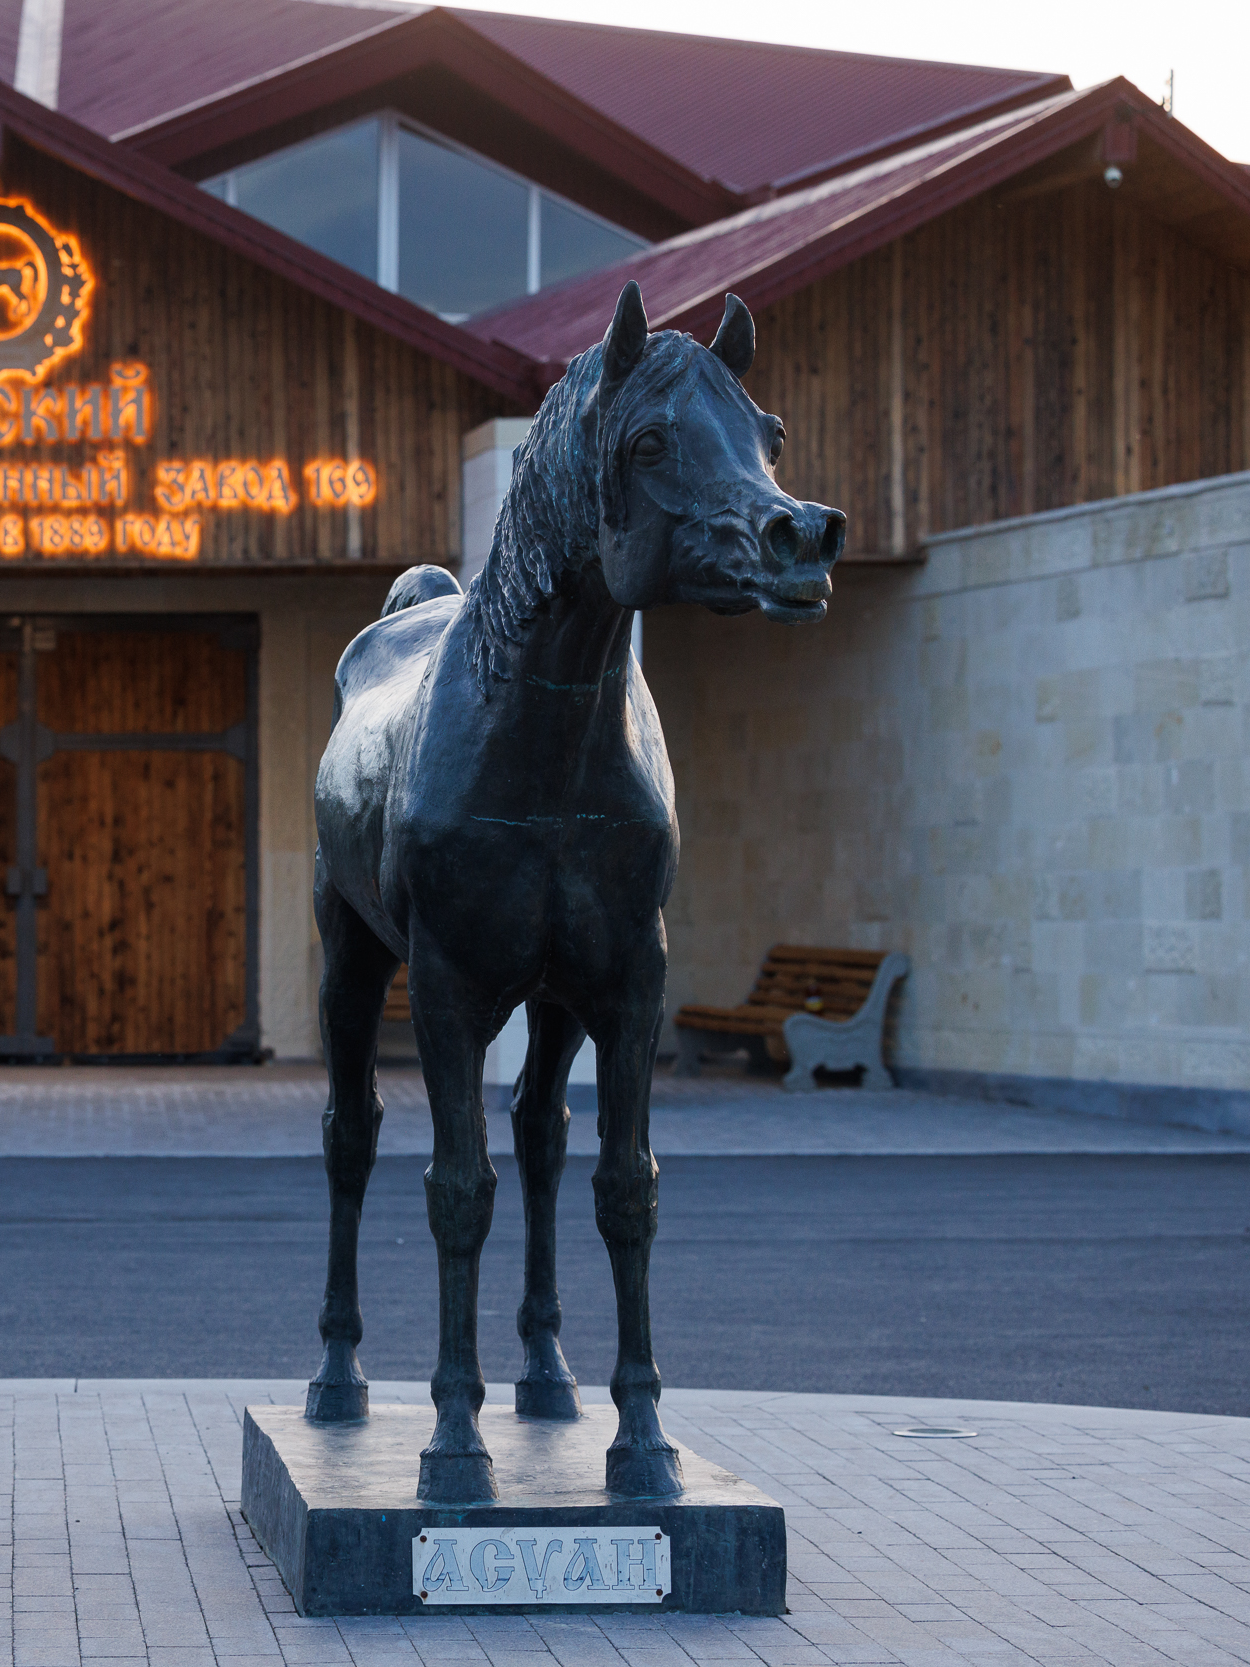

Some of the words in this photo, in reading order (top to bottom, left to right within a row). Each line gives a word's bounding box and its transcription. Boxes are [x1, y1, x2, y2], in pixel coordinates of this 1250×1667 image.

[161, 464, 291, 507] ЗАВОД
[309, 463, 372, 501] 169
[2, 517, 21, 549] В
[35, 518, 104, 548] 1889
[121, 517, 199, 552] ГОДУ
[422, 1537, 664, 1599] АСУАН
